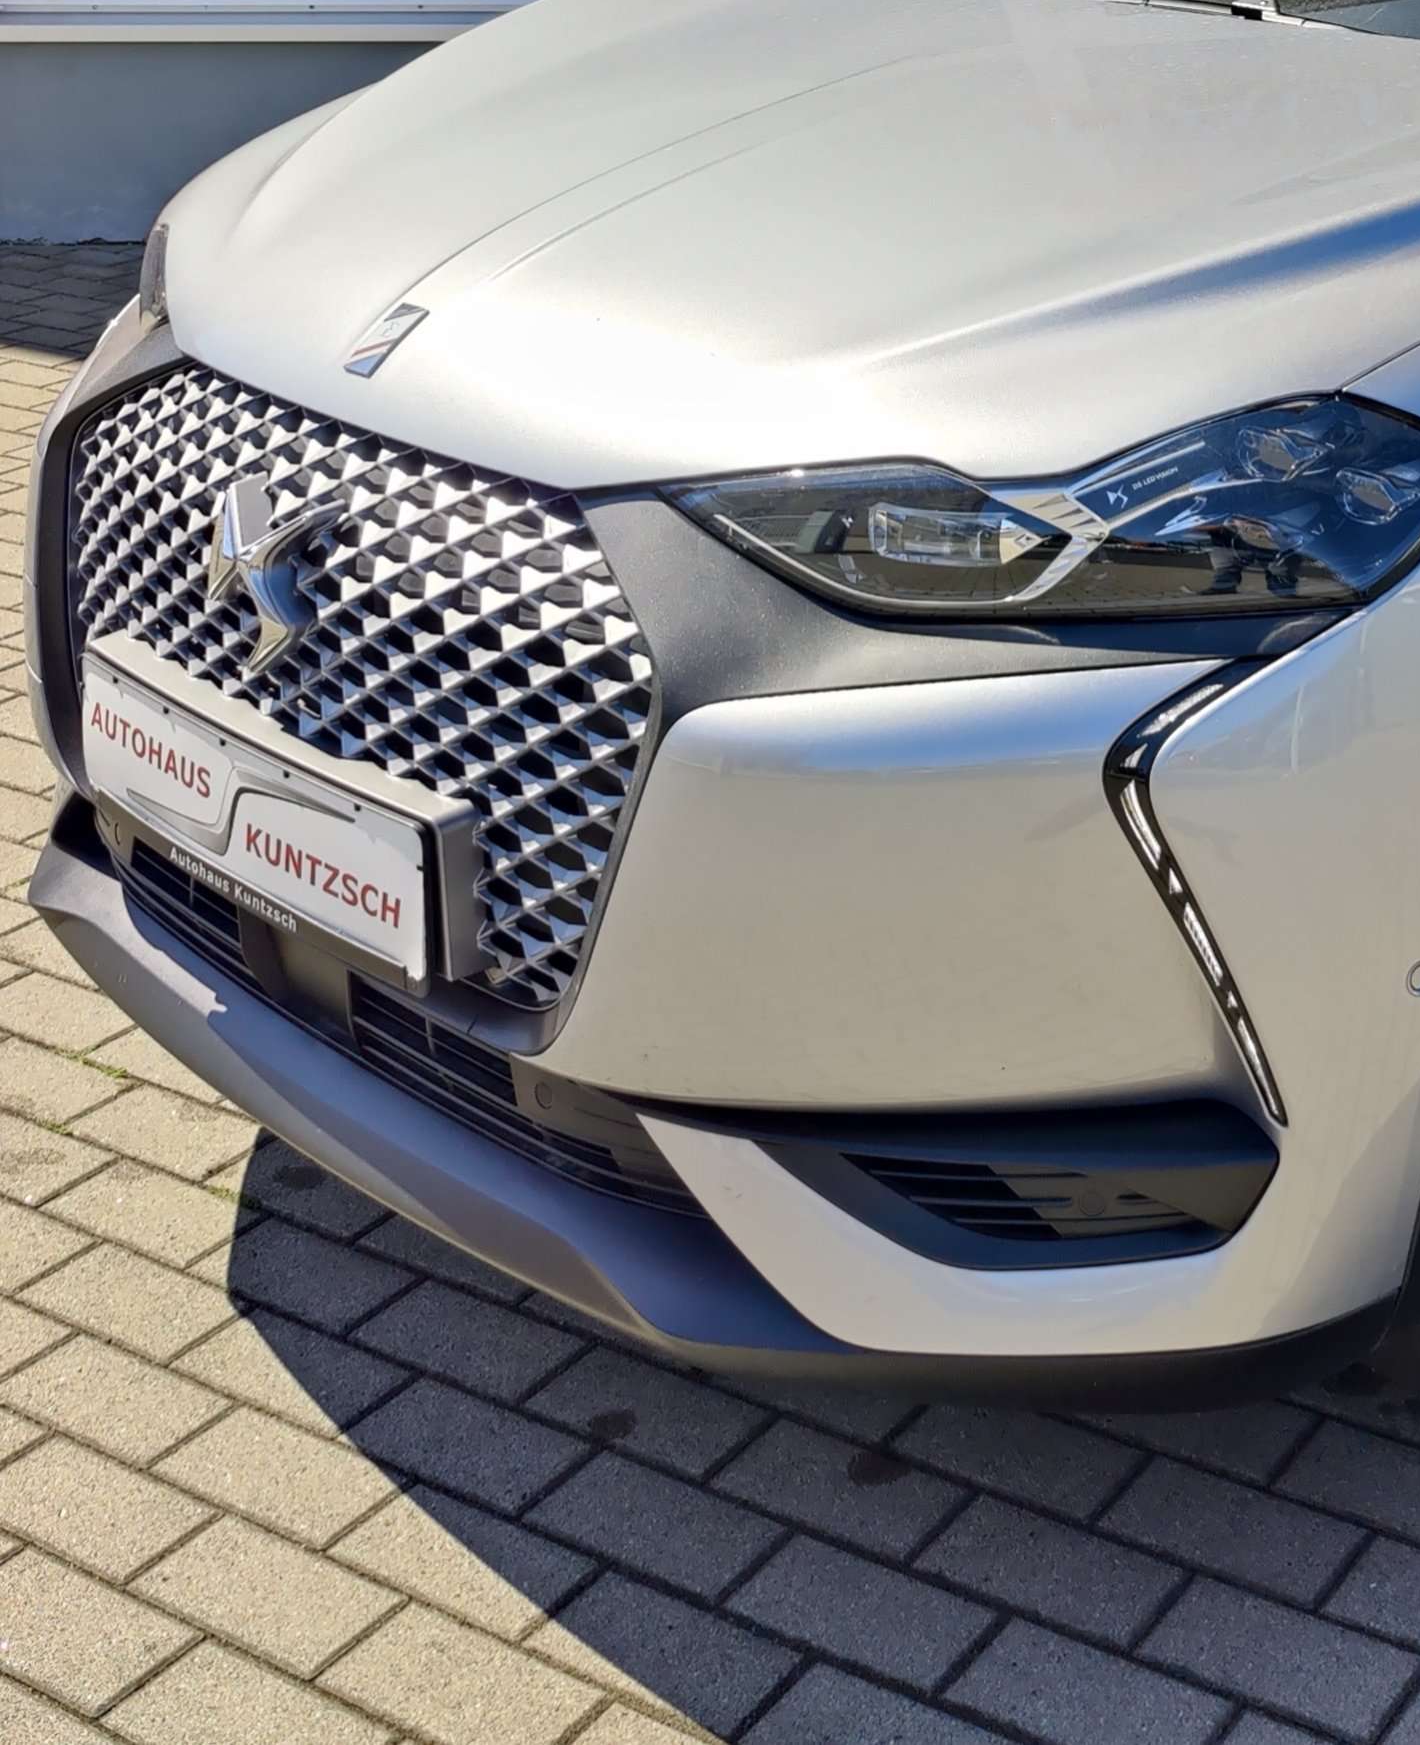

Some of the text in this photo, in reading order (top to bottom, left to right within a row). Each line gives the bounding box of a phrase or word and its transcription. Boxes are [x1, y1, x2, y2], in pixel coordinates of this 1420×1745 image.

[90, 701, 212, 801] AUTOHAUS
[169, 845, 297, 934] Autohaus Kuntzsch
[245, 822, 402, 929] KUNTZSCH
